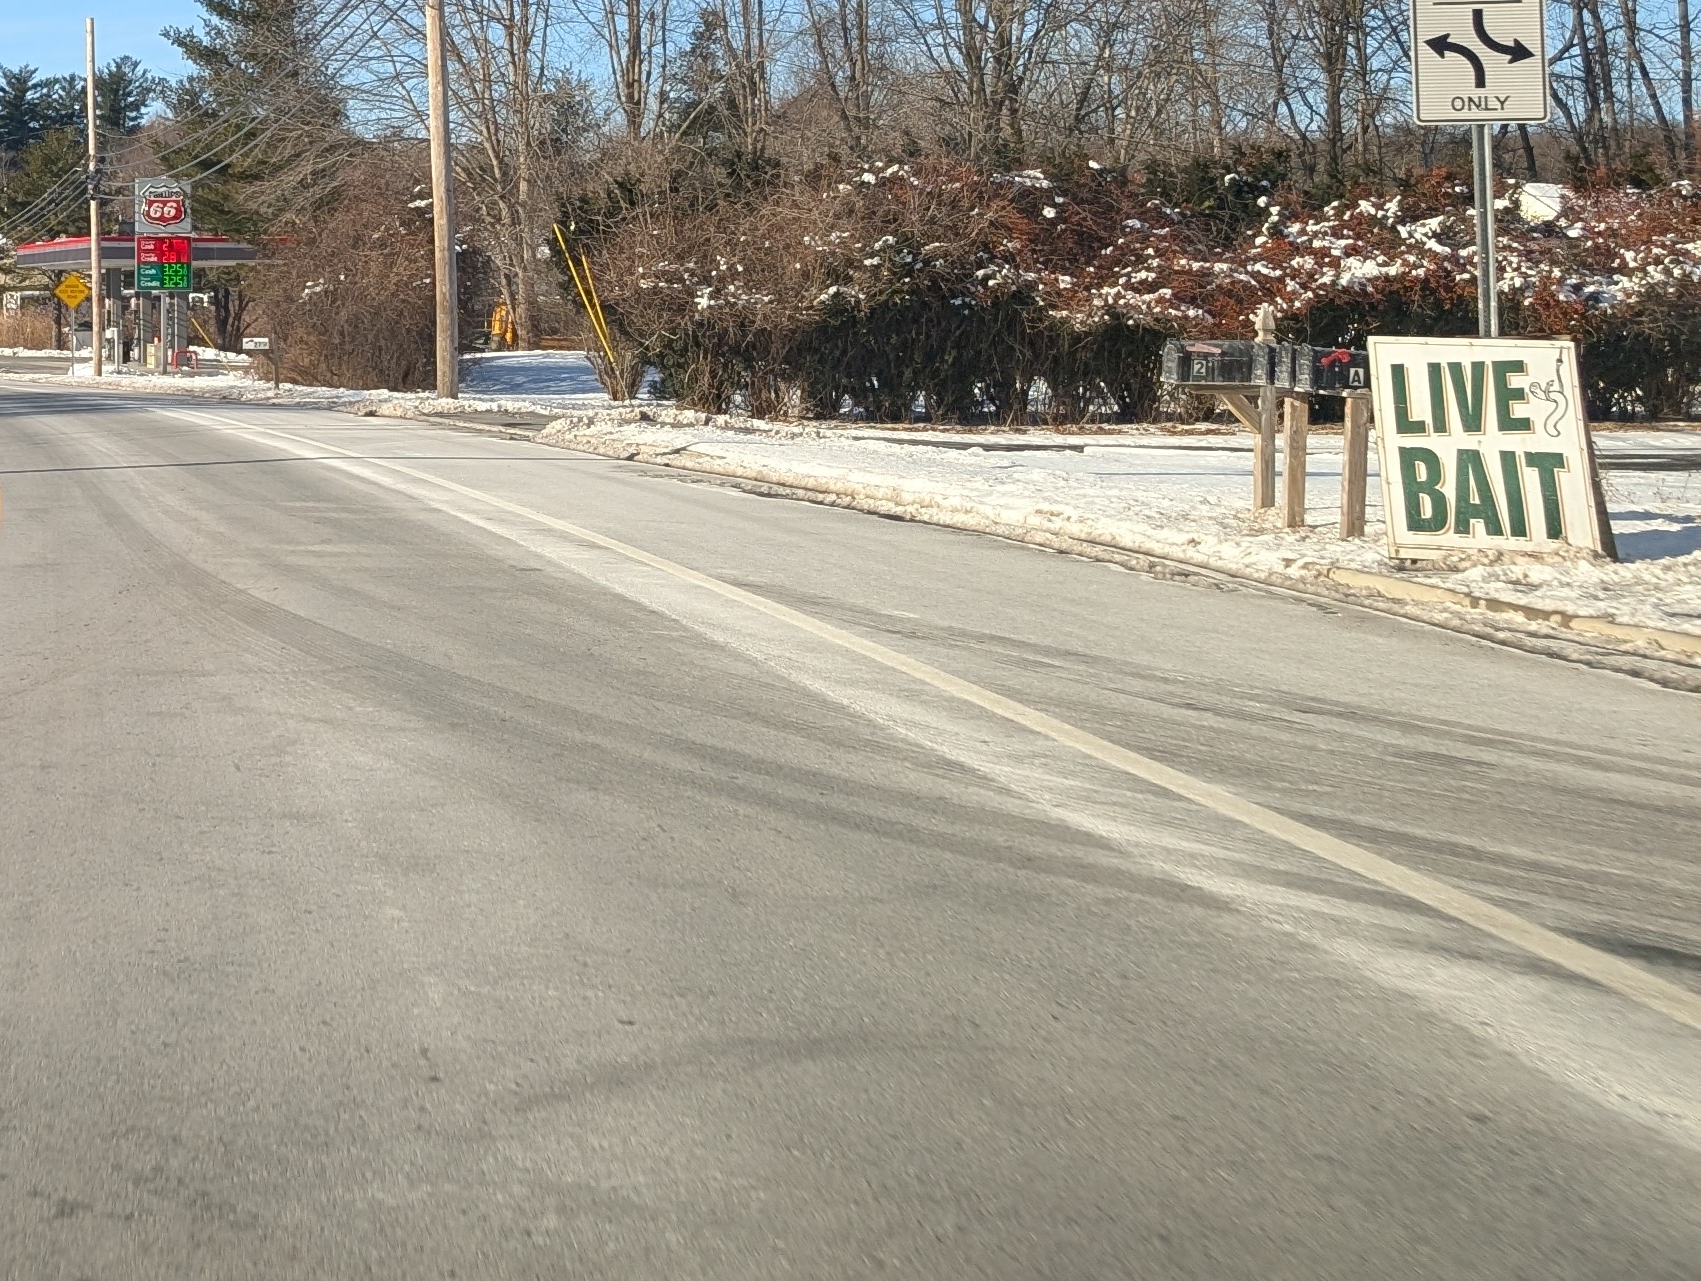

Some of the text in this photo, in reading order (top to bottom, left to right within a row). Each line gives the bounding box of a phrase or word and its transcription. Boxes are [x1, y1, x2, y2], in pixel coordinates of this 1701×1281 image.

[1450, 95, 1511, 112] ONLY
[149, 202, 177, 218] 66
[1195, 361, 1205, 375] 2
[1350, 369, 1362, 384] A
[1390, 359, 1534, 437] LIVE
[1397, 446, 1569, 542] BAIT
